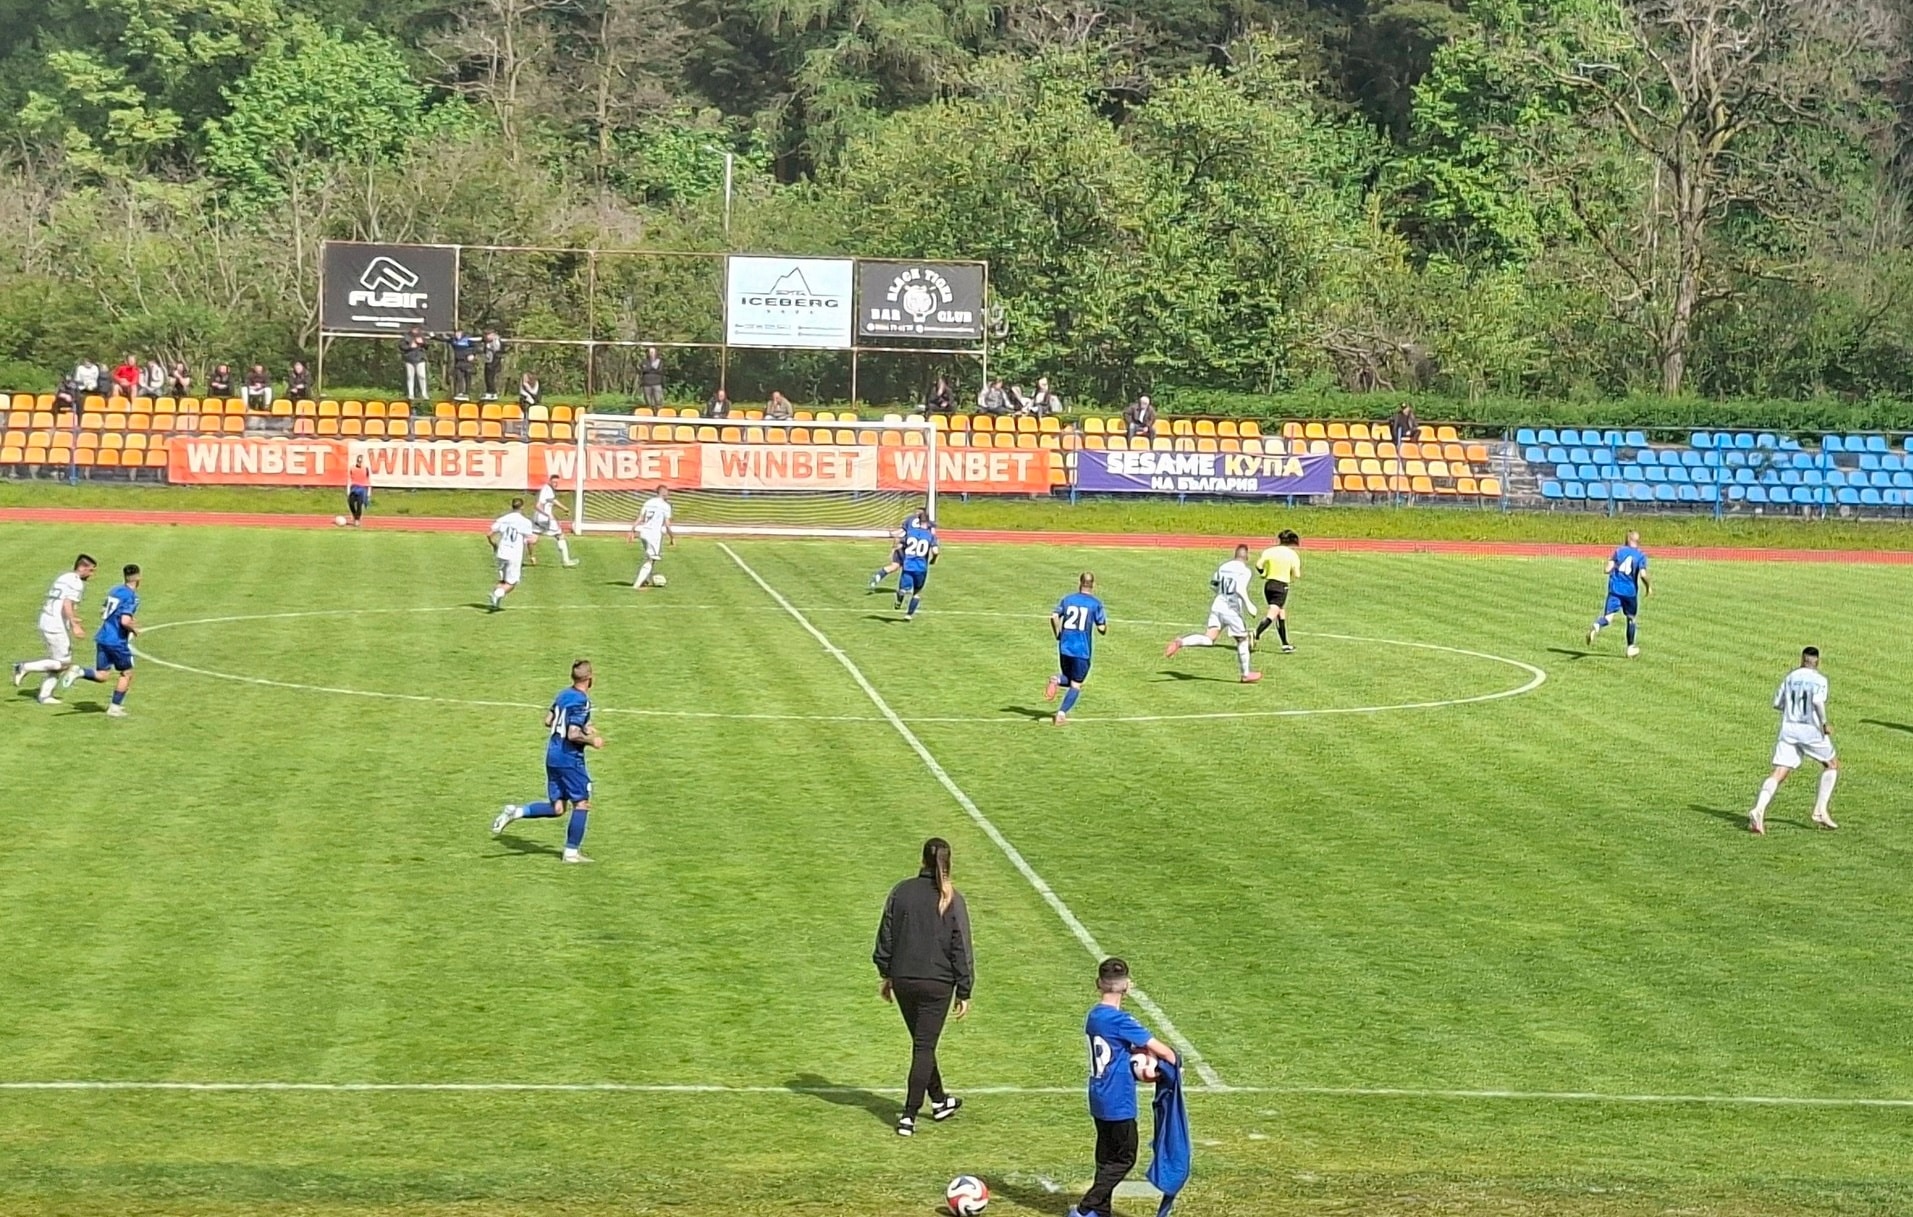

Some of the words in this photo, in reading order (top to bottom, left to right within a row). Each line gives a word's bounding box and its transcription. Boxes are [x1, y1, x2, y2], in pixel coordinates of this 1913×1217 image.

[741, 297, 839, 308] ICEBERG
[870, 308, 901, 321] BAR
[937, 311, 973, 323] CLUB
[187, 443, 332, 475] WINBET
[368, 446, 508, 477] WINBET
[544, 449, 685, 479] WNBET
[720, 449, 860, 479] WINBET
[894, 451, 1034, 482] WNBET
[1107, 453, 1215, 475] SESAME
[1225, 455, 1304, 477] КУПА
[1151, 477, 1174, 490] НА
[1178, 478, 1258, 491] БЪЛГАРИЯ
[905, 537, 929, 557] 20
[1618, 555, 1632, 575] 4
[1064, 606, 1088, 631] 21
[1791, 690, 1807, 716] 11
